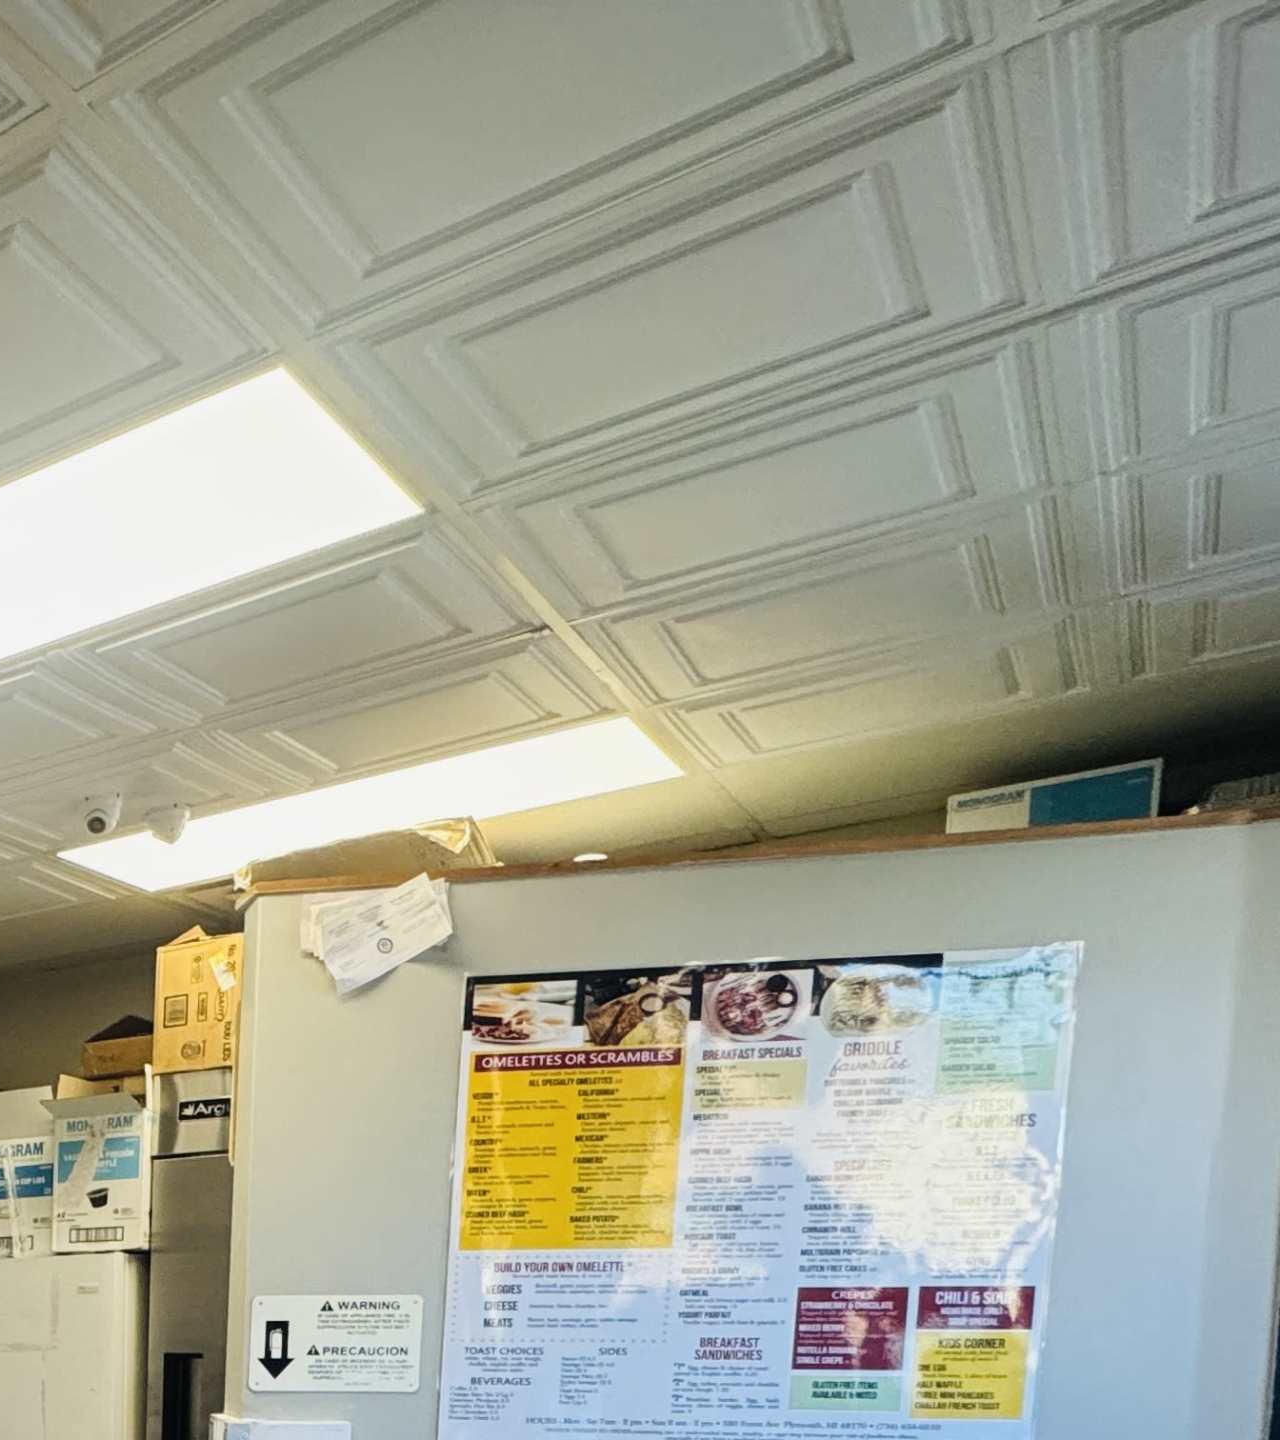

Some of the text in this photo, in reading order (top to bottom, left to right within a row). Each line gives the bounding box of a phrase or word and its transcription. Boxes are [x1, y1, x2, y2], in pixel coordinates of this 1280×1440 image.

[702, 1046, 802, 1060] BREAKFAST SPECIALS
[843, 1040, 903, 1057] GRIDDLE
[481, 1049, 675, 1068] OMELETTES OR SCRAMBLES
[66, 1115, 134, 1134] MONRAM
[494, 1262, 521, 1273] BUILD
[524, 1262, 549, 1273] YOUR
[551, 1262, 573, 1273] OWN
[935, 1291, 968, 1305] CHILI
[982, 1291, 1013, 1305] SOU
[337, 1301, 401, 1311] WARNING
[483, 1301, 518, 1311] CHEESE
[483, 1318, 513, 1328] MEATS
[699, 1337, 760, 1348] BREAKFAST
[964, 1338, 1006, 1349] CORNER
[322, 1346, 409, 1356] PRECAUCION
[464, 1346, 544, 1356] TOAST CHOICES
[598, 1347, 628, 1356] SIDES
[694, 1349, 763, 1360] SANDWICHES
[470, 1377, 532, 1386] BEVERAGES
